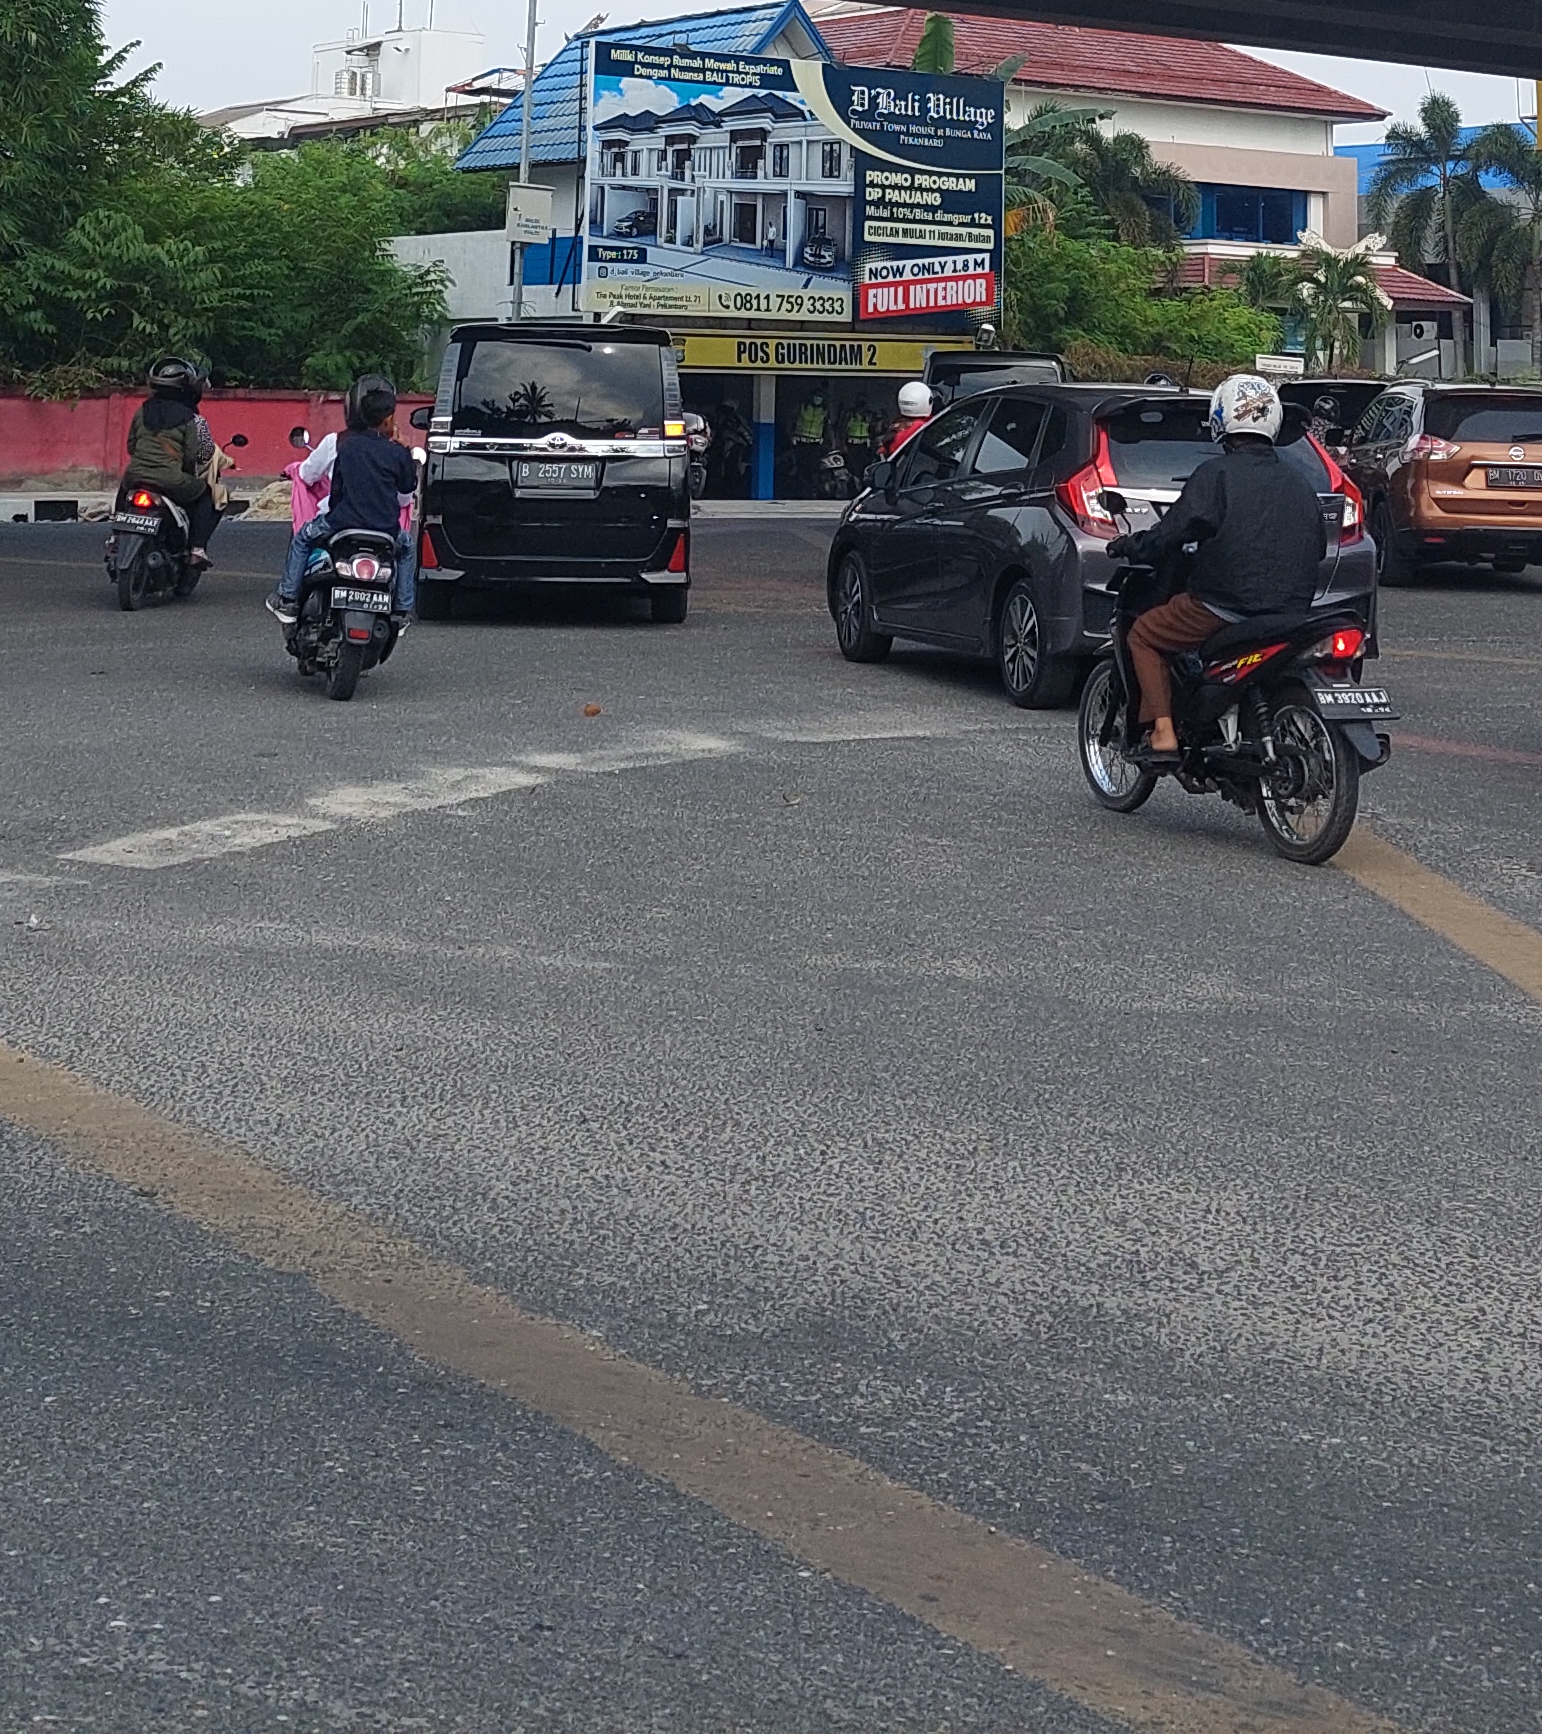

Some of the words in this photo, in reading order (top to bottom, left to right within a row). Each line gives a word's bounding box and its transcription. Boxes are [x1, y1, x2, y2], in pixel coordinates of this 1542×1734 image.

[611, 49, 635, 62] Miliki
[637, 51, 671, 67] Konsep
[673, 55, 703, 69] Rumah
[705, 58, 737, 72] Mewah
[739, 61, 784, 76] Expatriate
[634, 65, 669, 80] Dengan
[670, 67, 704, 81] Nuansa
[705, 71, 726, 84] BALI
[728, 73, 761, 86] TROPIS
[926, 93, 996, 130] Village
[850, 119, 882, 131] PRIVATE
[883, 121, 907, 133] TOWN
[909, 123, 936, 136] HOUSE
[945, 127, 972, 139] BUNGA
[973, 129, 993, 141] RAYA
[899, 134, 944, 147] PEKANBARU
[865, 170, 912, 187] PROMO
[914, 174, 976, 192] PROGRAM
[865, 187, 883, 201] DP
[885, 189, 942, 206] PANJANG
[865, 205, 891, 218] Mulai
[934, 209, 972, 225] diangsur
[974, 212, 993, 224] 12x
[867, 225, 900, 238] CICILAN
[901, 227, 926, 240] MULAI
[927, 230, 936, 241] 11
[597, 248, 617, 260] Type
[622, 248, 639, 260] 175
[868, 264, 907, 282] NOW
[910, 259, 948, 277] ONLY
[951, 258, 970, 274] 1.8
[973, 256, 986, 272] M
[733, 291, 773, 313] 0811
[775, 293, 804, 314] 759
[806, 295, 845, 316] 3333
[867, 286, 906, 314] FULL
[909, 278, 987, 309] INTERIOR
[736, 341, 771, 364] POS
[774, 341, 863, 366] GURINDAM
[866, 344, 878, 367] 2
[521, 462, 530, 478] B
[537, 462, 567, 479] 2557
[570, 464, 593, 480] SYM
[1488, 468, 1500, 481] BM
[334, 589, 347, 600] BM
[348, 590, 372, 603] 2002
[1316, 692, 1335, 705] BM
[1334, 692, 1365, 705] 3920
[1364, 691, 1388, 704] AAJ
